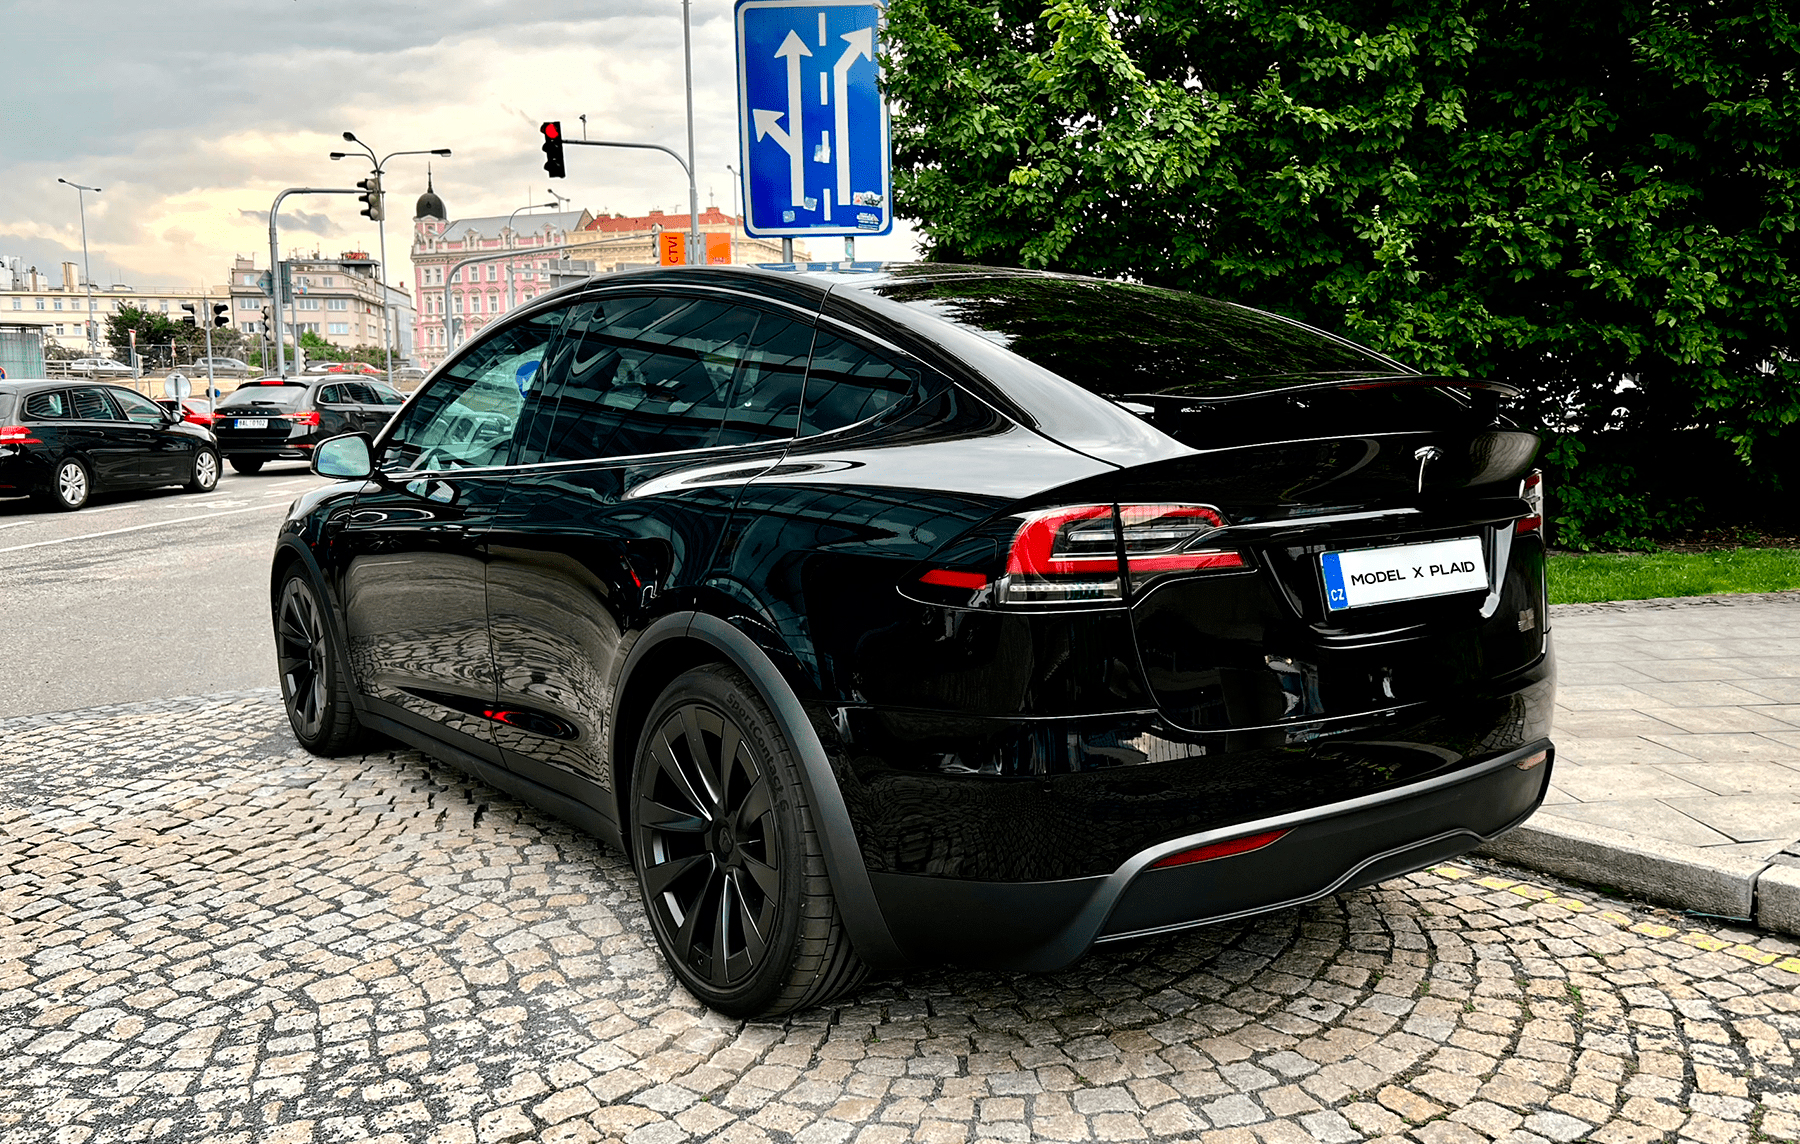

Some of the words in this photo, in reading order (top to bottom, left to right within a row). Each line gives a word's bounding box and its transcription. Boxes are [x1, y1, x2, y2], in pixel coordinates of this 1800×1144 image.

[1350, 569, 1406, 586] MODEL
[1412, 566, 1424, 579] X
[1429, 561, 1475, 577] PLAID
[1330, 588, 1345, 601] CZ
[725, 692, 785, 795] SportContact
